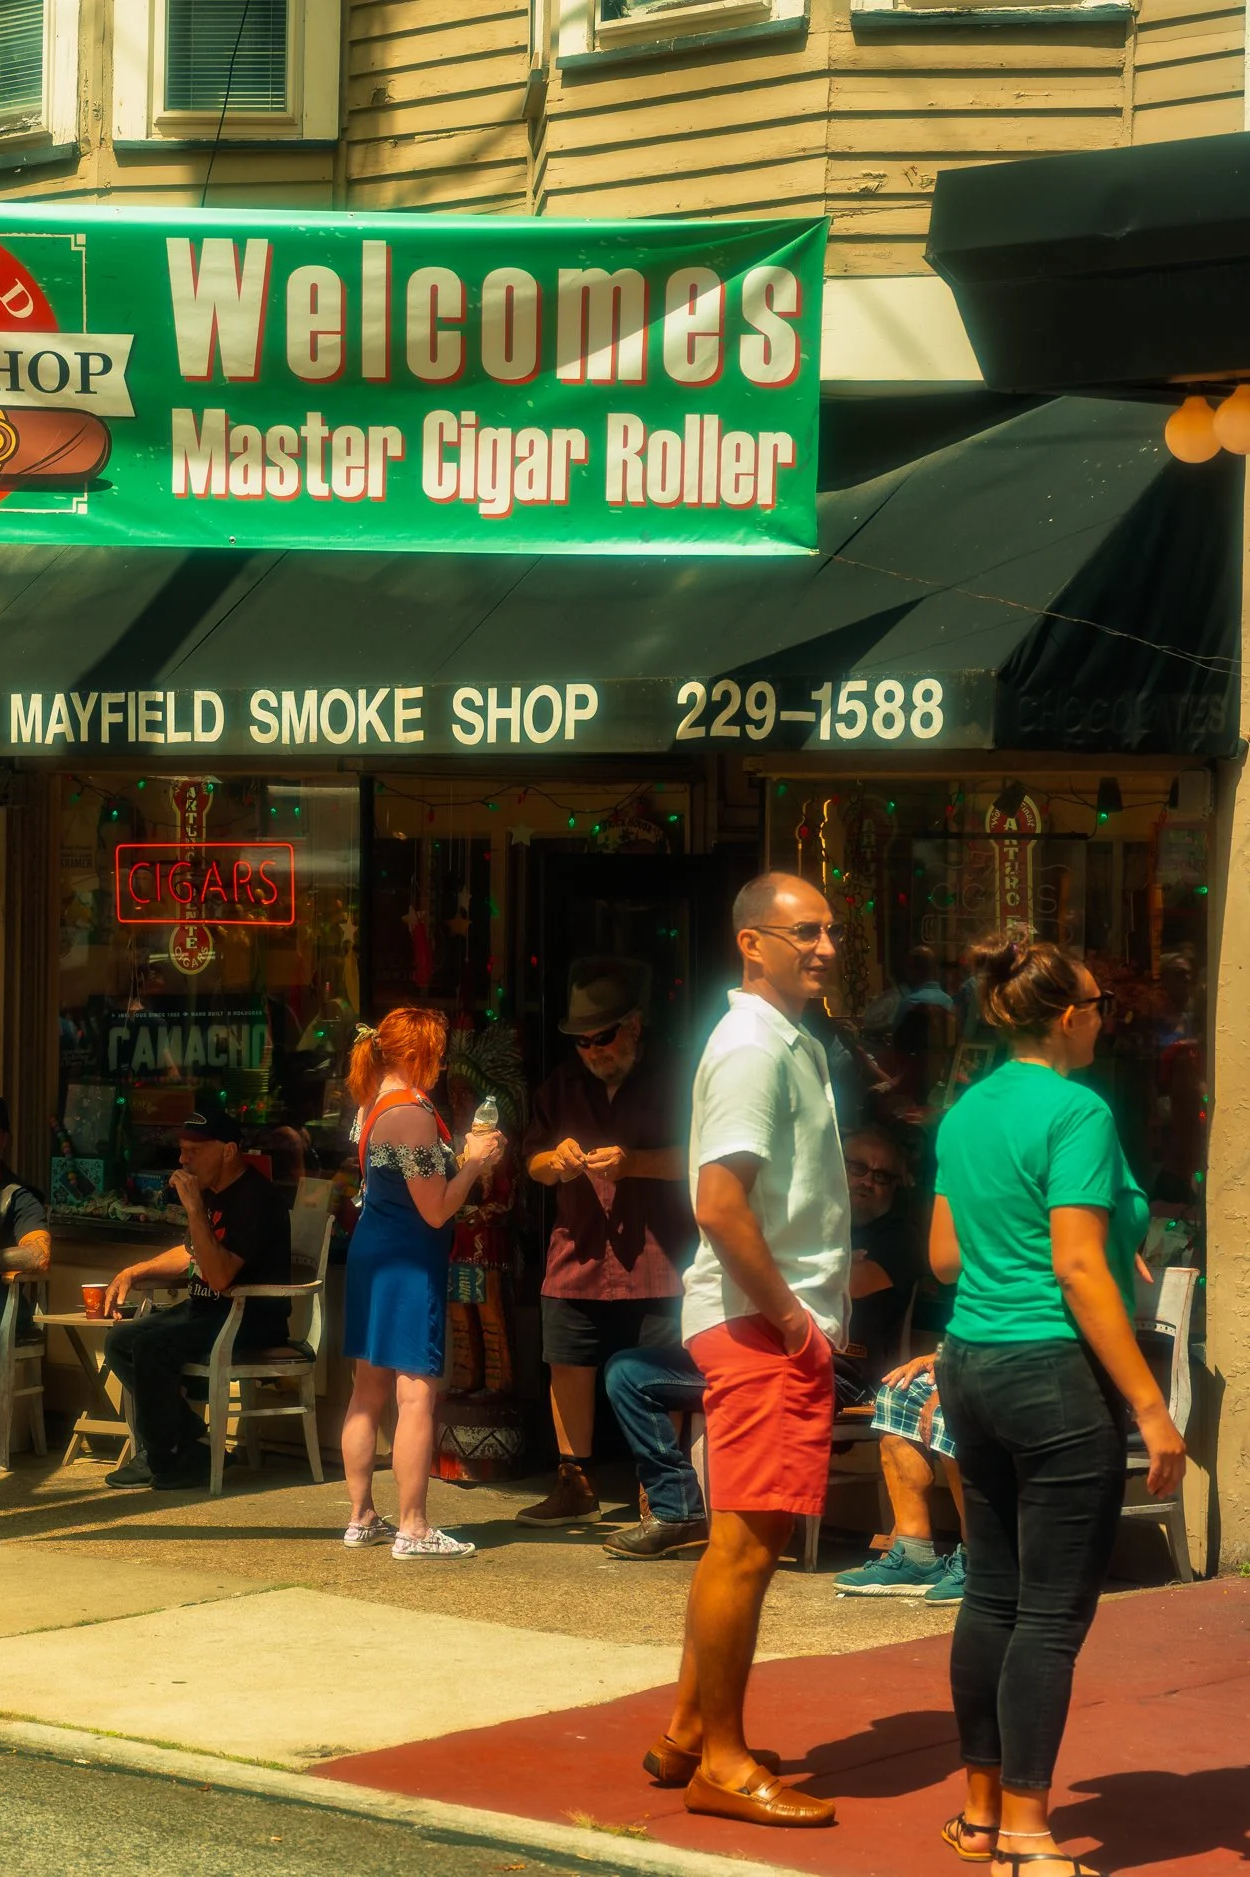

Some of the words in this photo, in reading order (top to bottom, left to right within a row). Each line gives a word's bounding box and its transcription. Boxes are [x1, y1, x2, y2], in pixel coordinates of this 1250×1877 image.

[165, 237, 801, 386] Welcomes
[171, 408, 406, 502] Master
[421, 410, 589, 520] Cigar
[605, 411, 798, 510] Roller
[9, 690, 224, 745] MAYFIELD
[249, 686, 425, 745] SMOKE
[451, 683, 599, 745] SHOP
[676, 679, 944, 743] 229-1588
[128, 861, 279, 905] CIGARS
